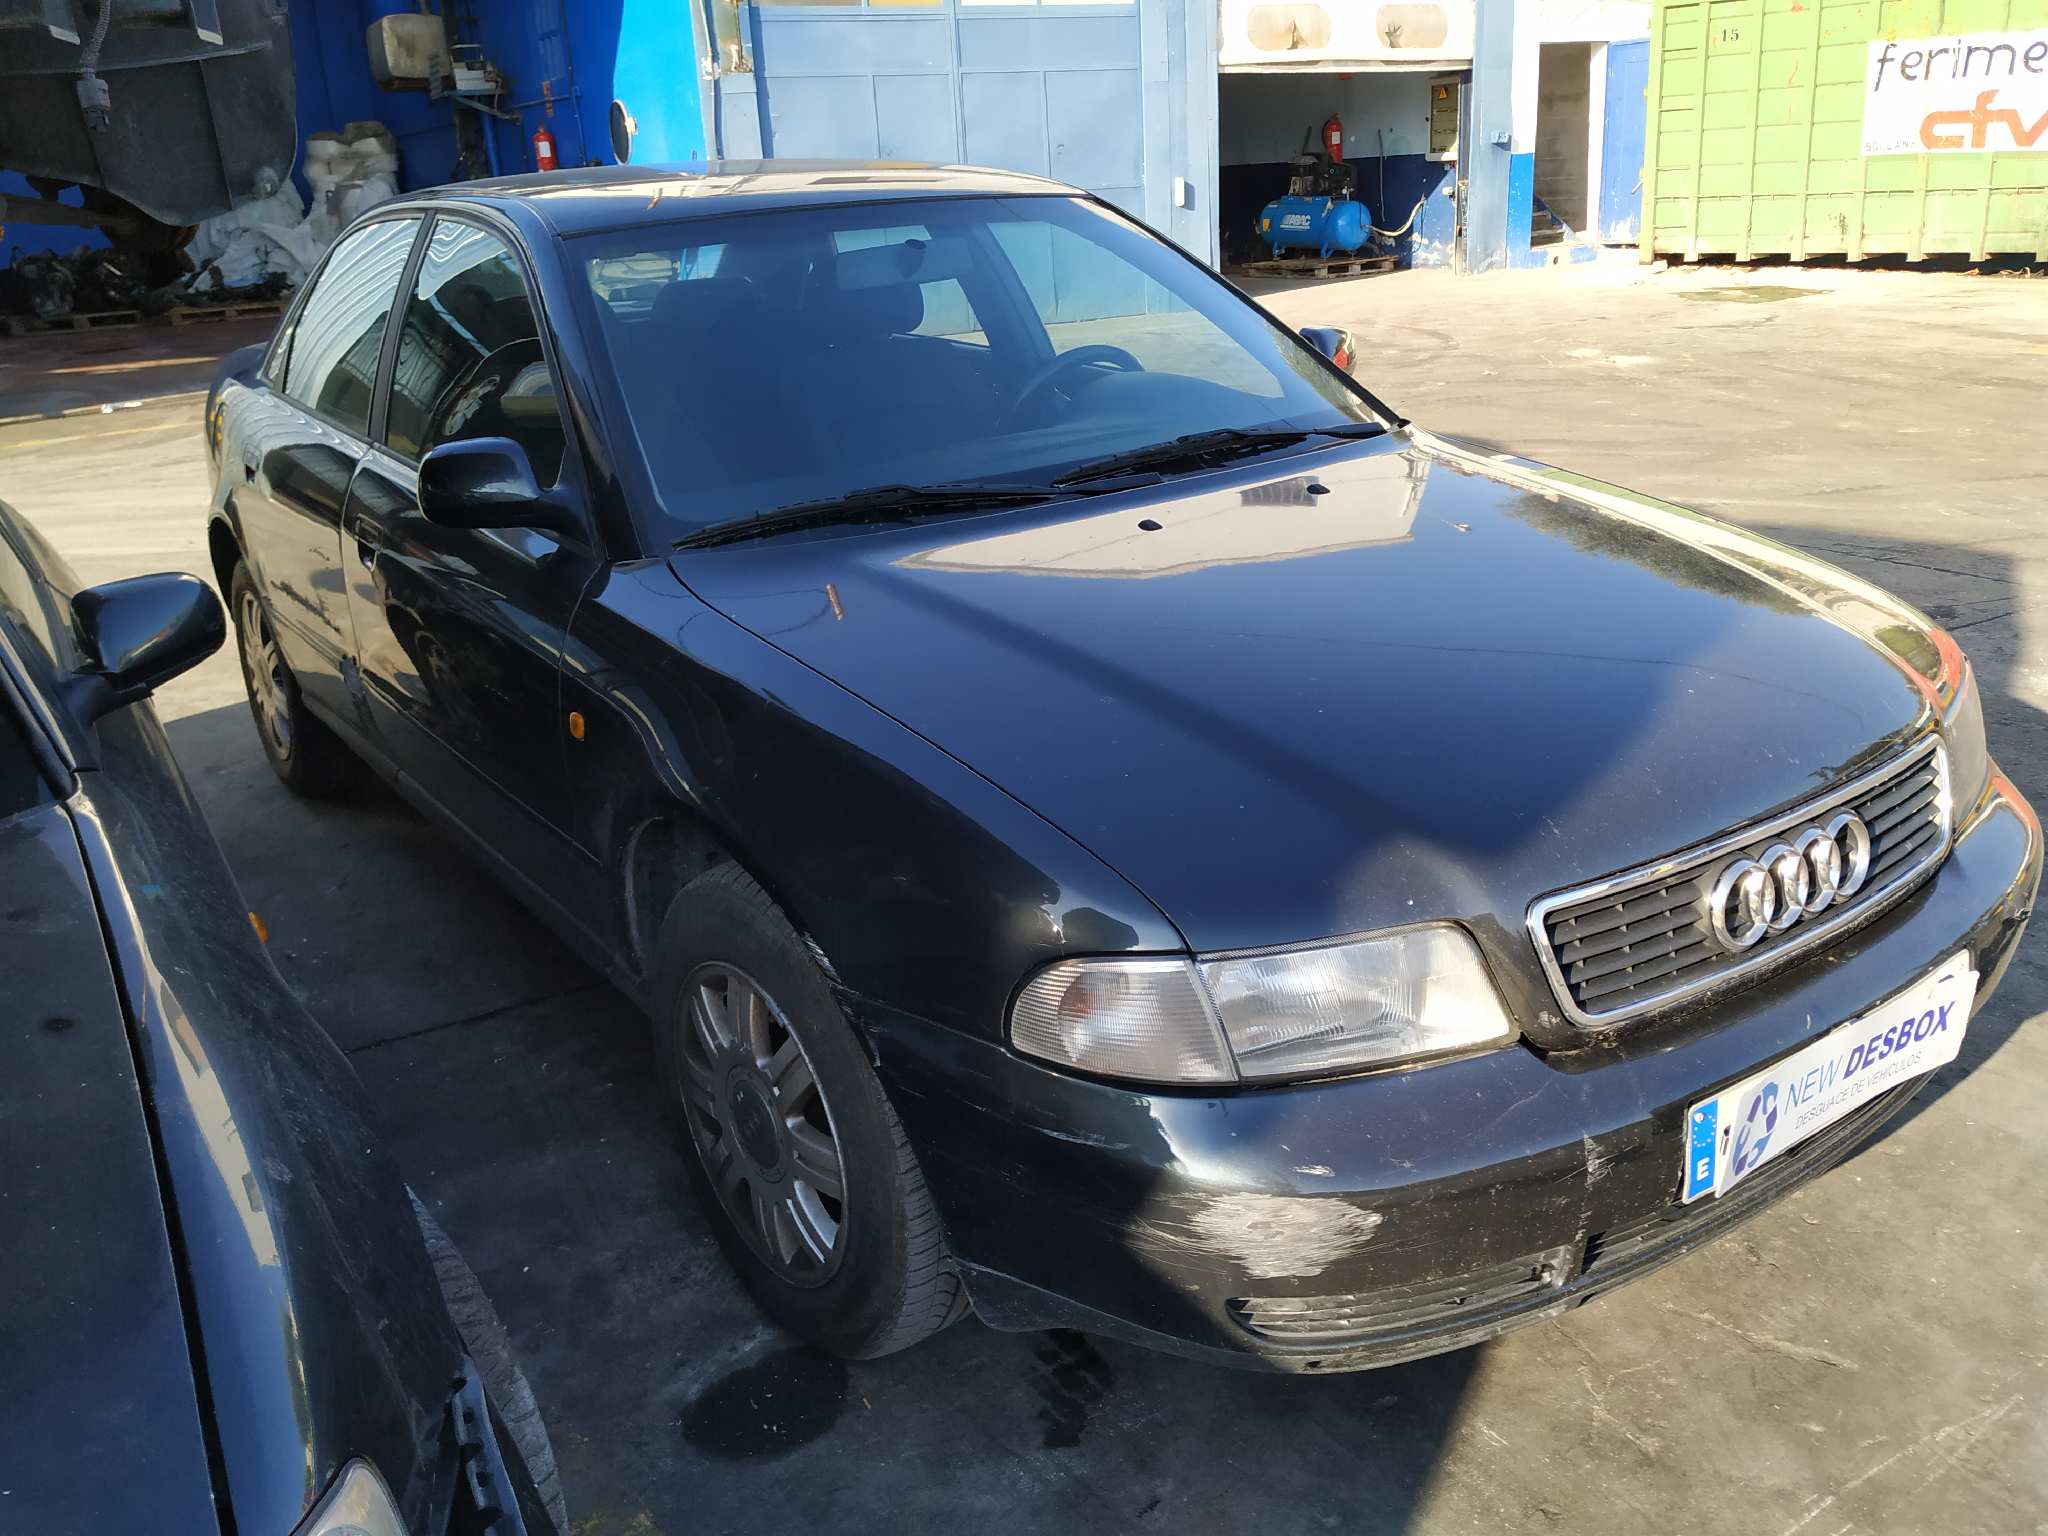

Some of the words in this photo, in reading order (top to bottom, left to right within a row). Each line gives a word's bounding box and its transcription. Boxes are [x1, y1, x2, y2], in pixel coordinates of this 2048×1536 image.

[1721, 28, 1740, 42] 15
[1784, 1055, 1843, 1115] NEW
[1842, 1000, 1956, 1080] DESBOX
[1795, 1088, 1850, 1129] DESGUACE
[1850, 1079, 1866, 1097] DE
[1696, 1157, 1710, 1182] E
